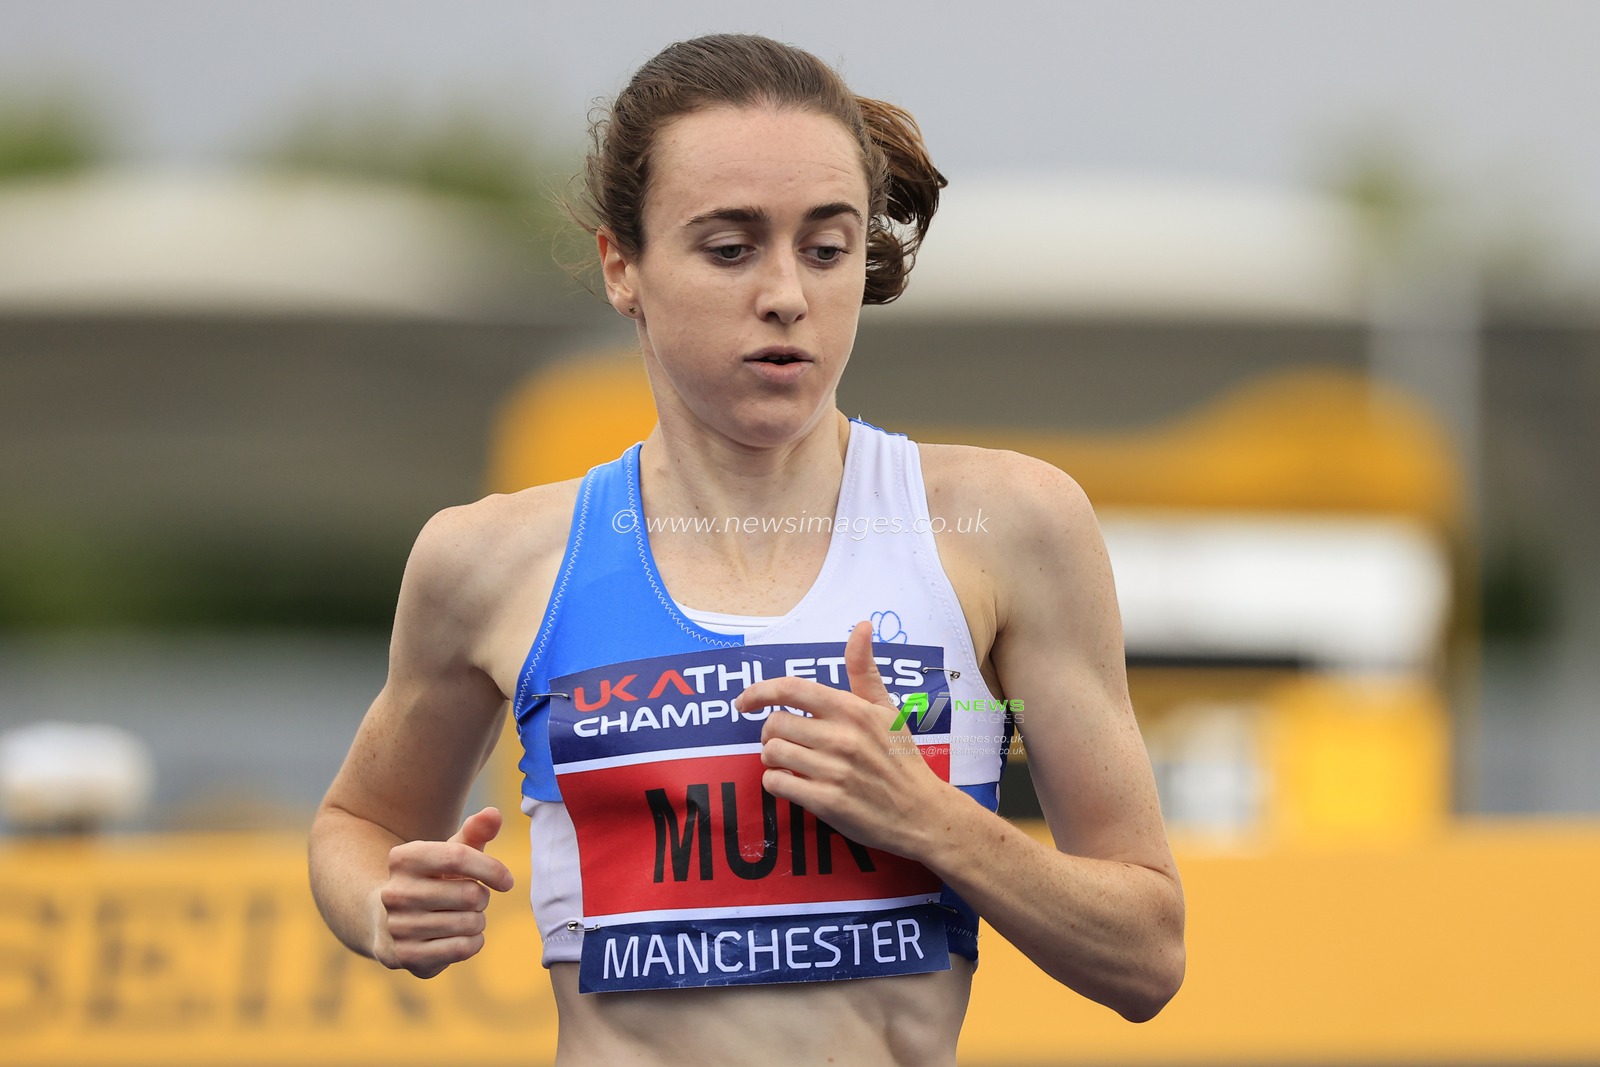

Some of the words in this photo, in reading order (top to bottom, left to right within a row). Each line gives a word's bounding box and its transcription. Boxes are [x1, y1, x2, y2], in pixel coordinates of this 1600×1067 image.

[574, 674, 639, 712] UK
[648, 656, 924, 699] ATHLETS
[603, 918, 924, 980] MANCHESTER
